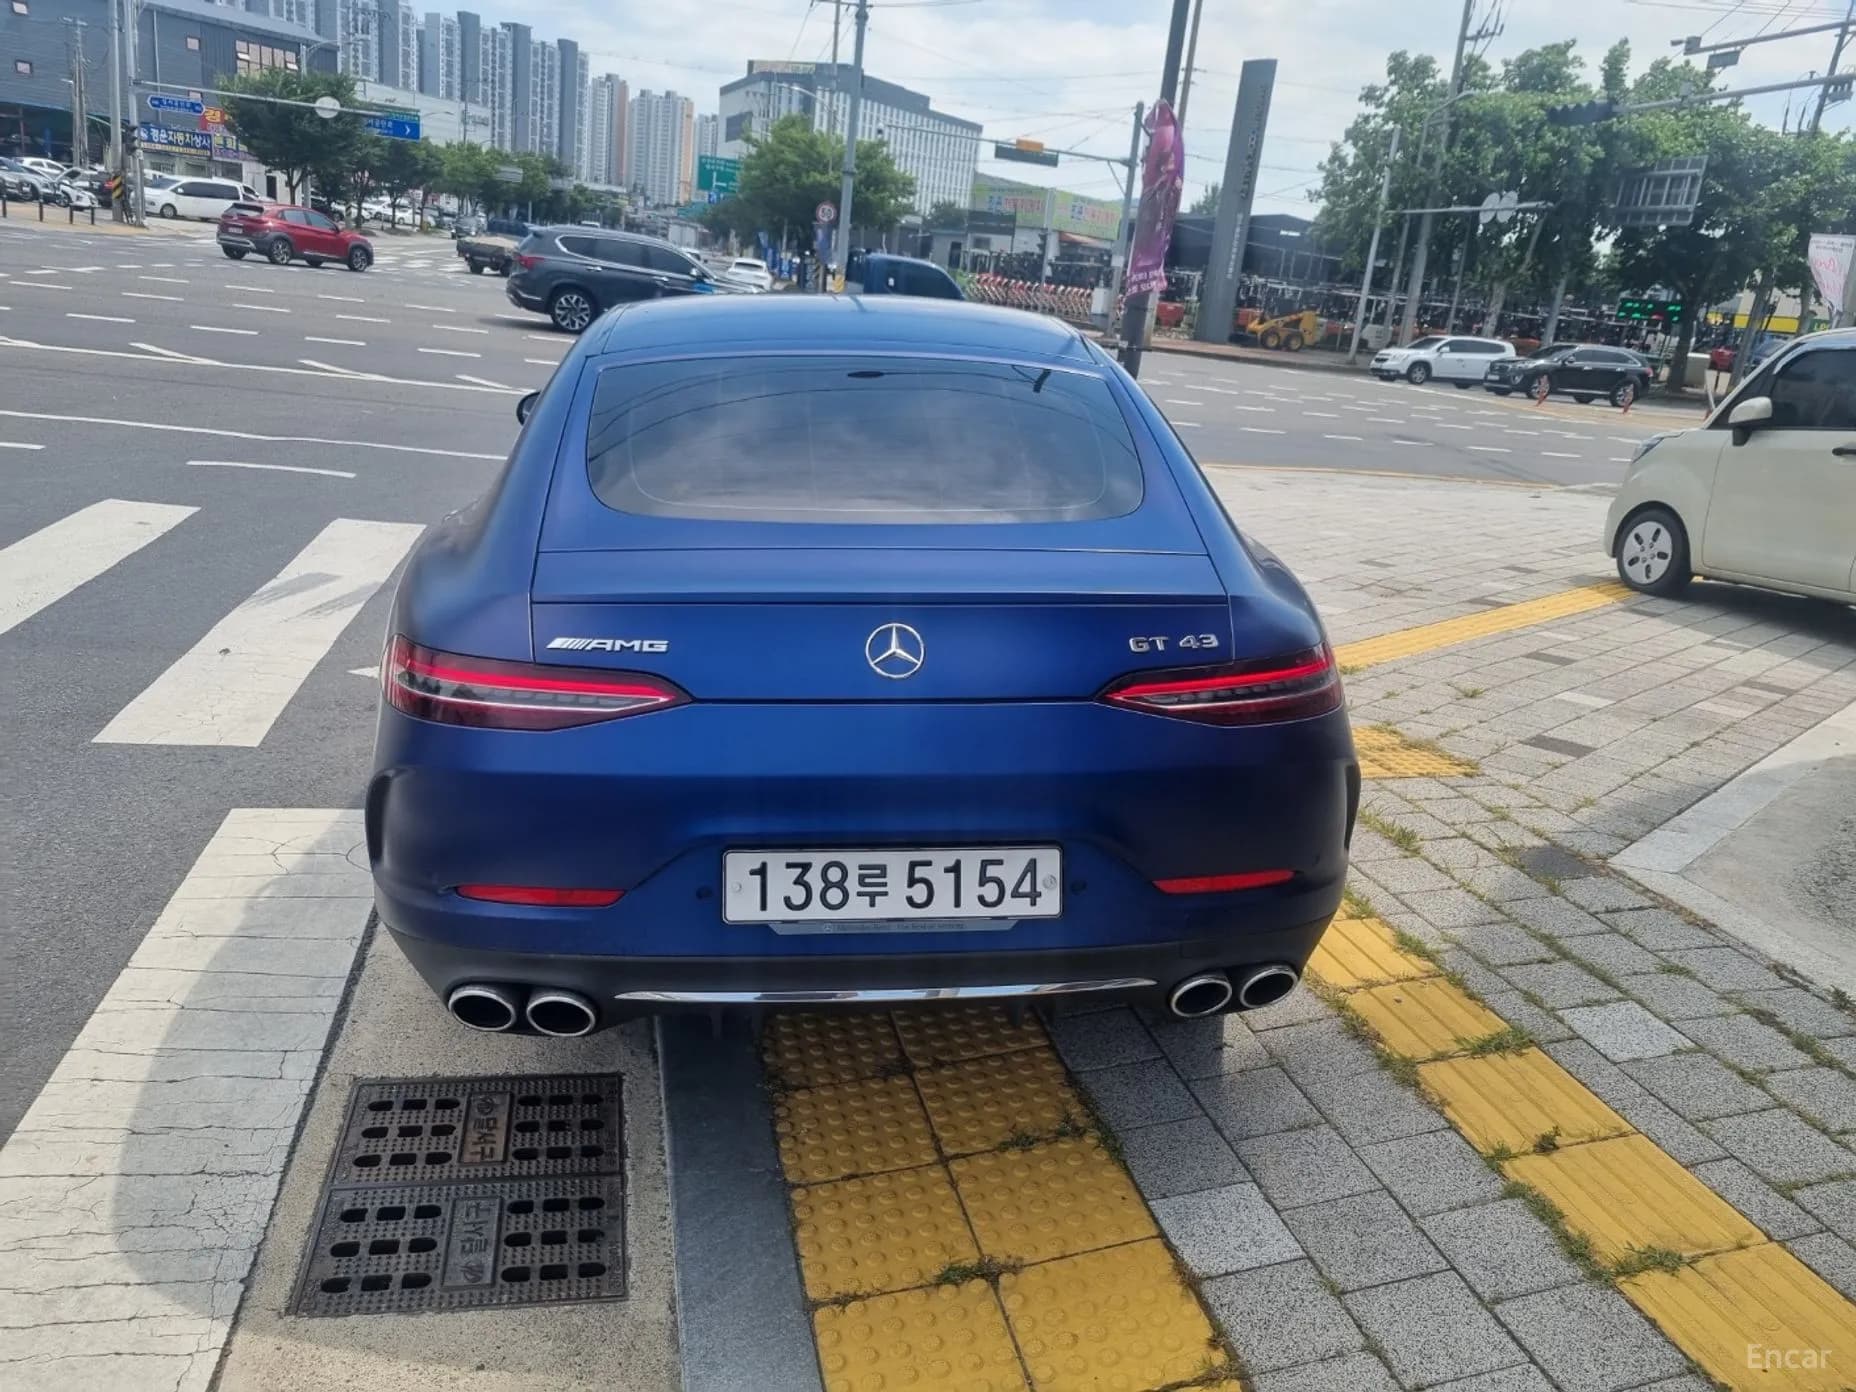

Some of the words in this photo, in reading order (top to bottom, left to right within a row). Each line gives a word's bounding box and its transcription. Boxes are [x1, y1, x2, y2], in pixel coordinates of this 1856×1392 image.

[583, 638, 669, 652] AMG
[1129, 636, 1169, 652] GT
[1179, 633, 1219, 649] 43
[749, 860, 889, 911] 138루
[905, 858, 1042, 909] 5154
